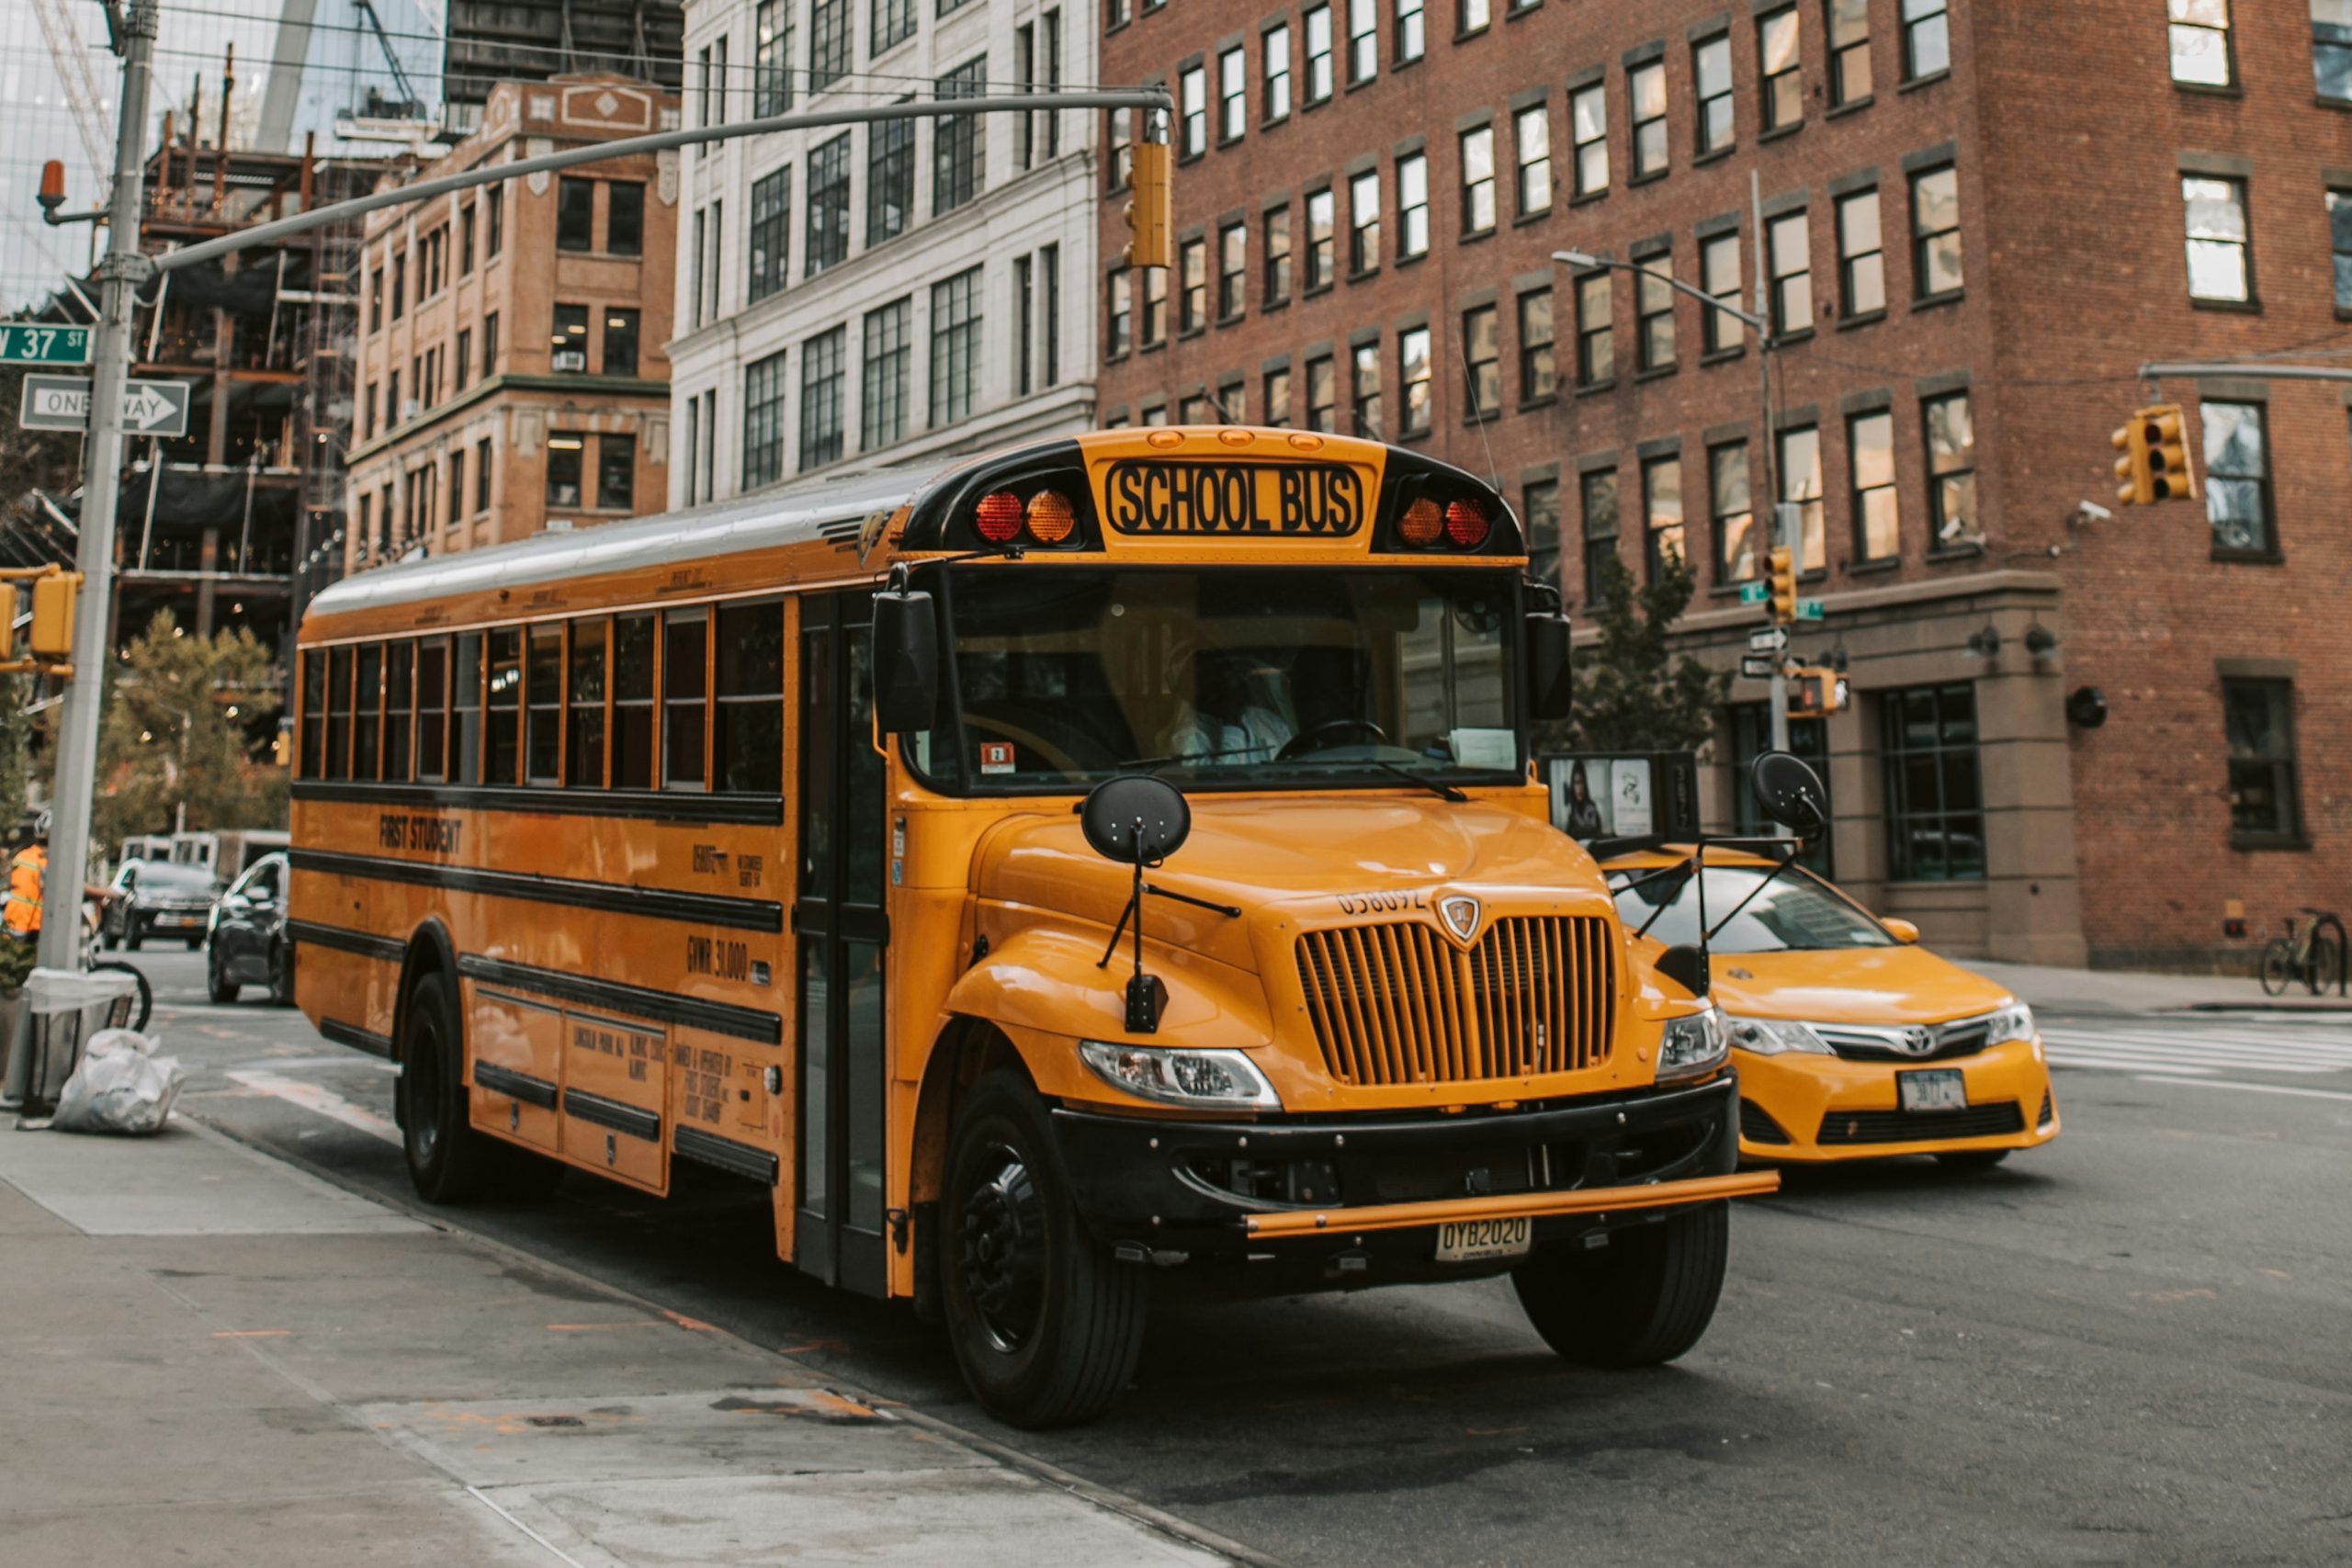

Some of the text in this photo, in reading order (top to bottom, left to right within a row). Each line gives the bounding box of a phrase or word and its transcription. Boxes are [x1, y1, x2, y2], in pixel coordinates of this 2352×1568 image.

[21, 329, 56, 359] 37
[67, 331, 84, 347] ST
[48, 393, 91, 413] ONE
[1119, 467, 1352, 534] SCHOOL BUS
[379, 814, 462, 854] FIRST STUDENT
